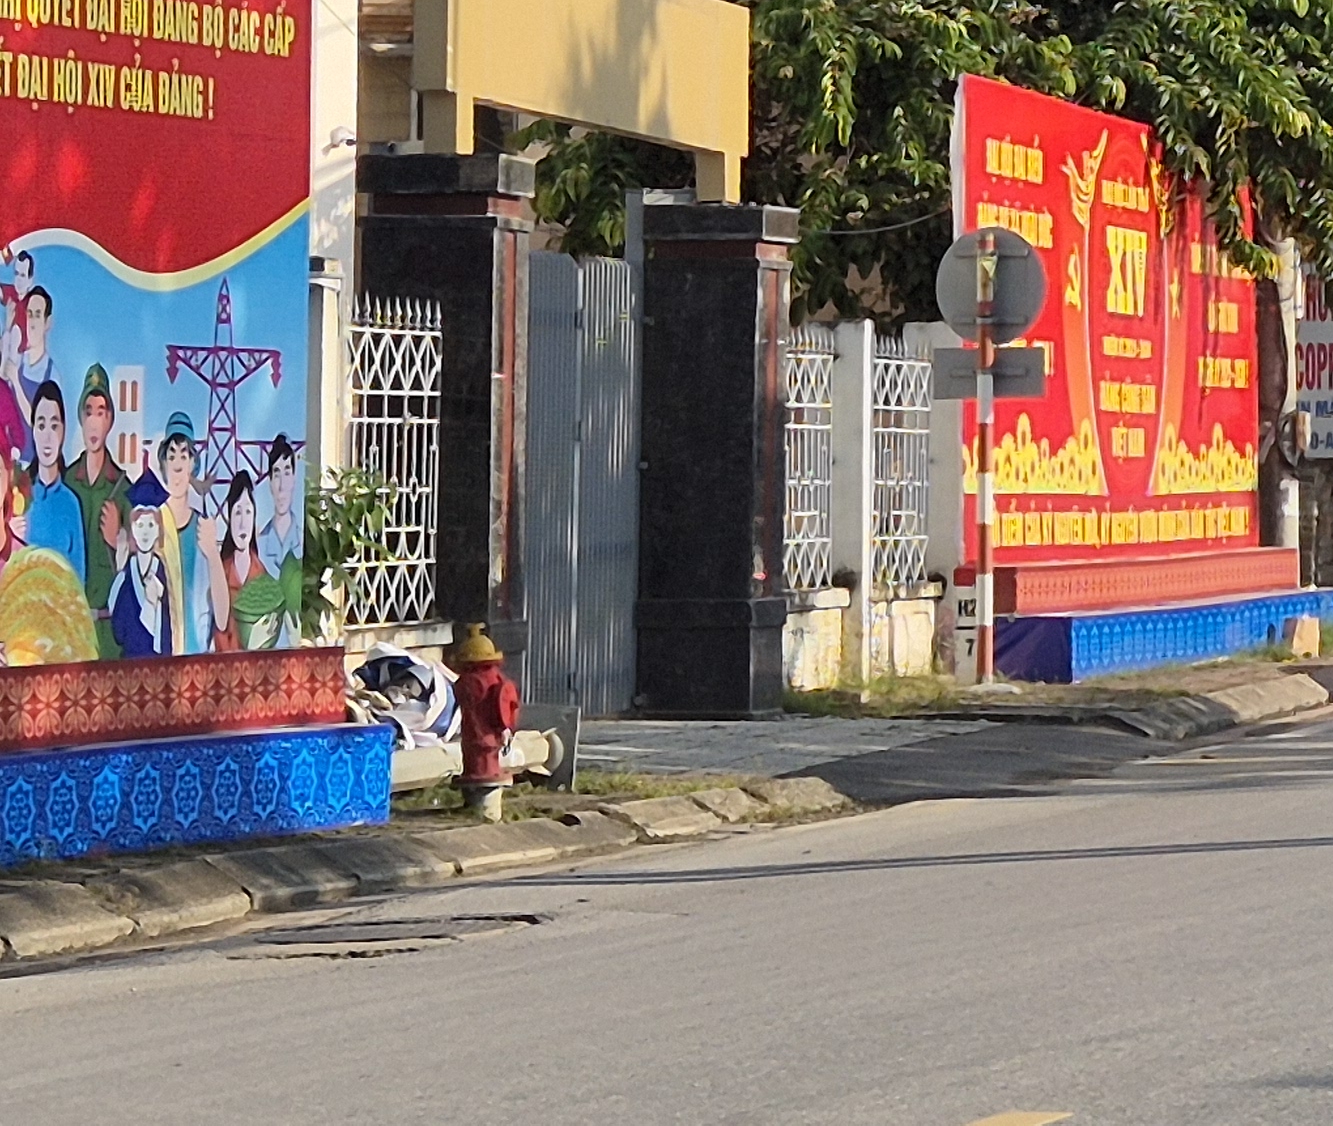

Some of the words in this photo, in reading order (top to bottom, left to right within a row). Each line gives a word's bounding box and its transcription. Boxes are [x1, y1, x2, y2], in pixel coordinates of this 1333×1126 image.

[228, 0, 261, 54] CÁC
[263, 0, 295, 58] CẤP
[17, 52, 49, 111] ĐẠI
[53, 48, 83, 114] HỘI
[87, 61, 116, 108] XIV
[119, 52, 155, 113] CỦA
[158, 57, 204, 119] ĐẢNG
[1105, 225, 1147, 317] XIV
